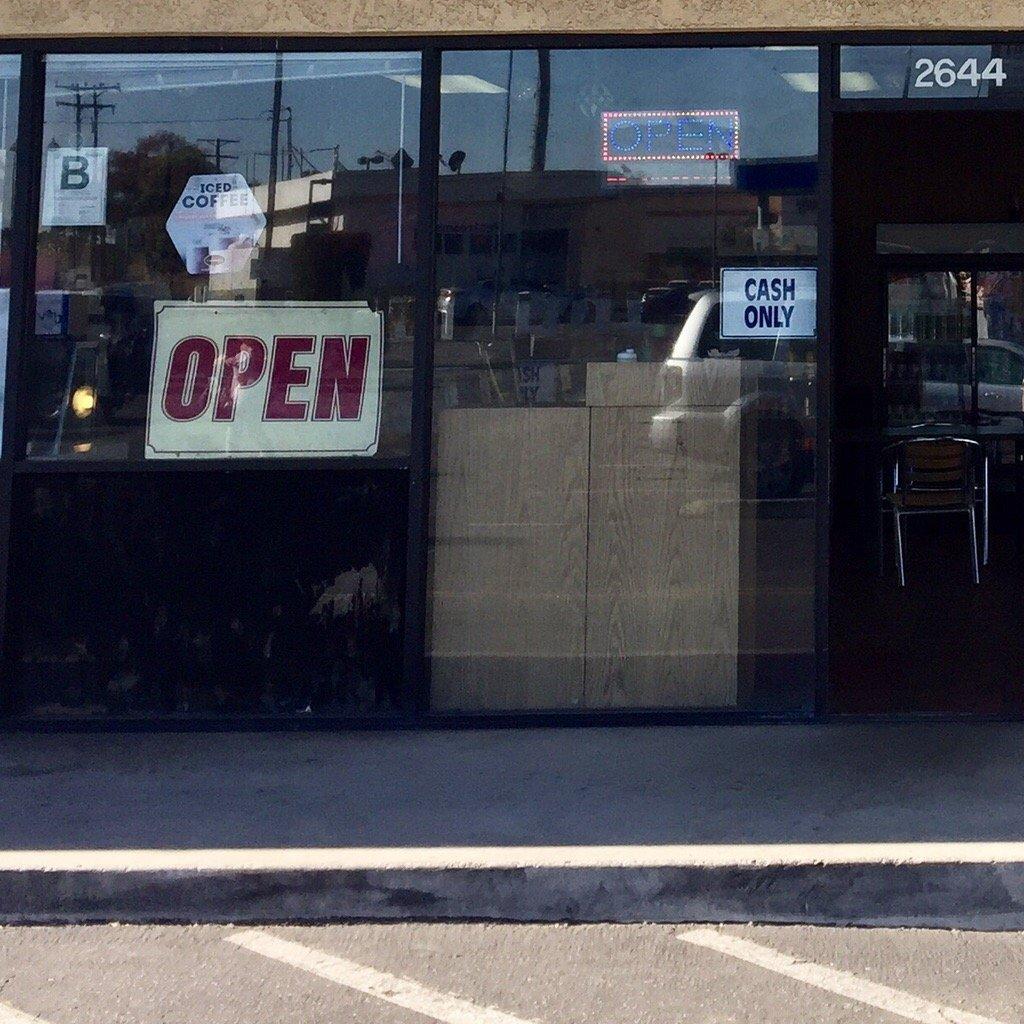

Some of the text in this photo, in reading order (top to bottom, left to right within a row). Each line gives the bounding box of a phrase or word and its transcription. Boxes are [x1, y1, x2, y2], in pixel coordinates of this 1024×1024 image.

[914, 57, 1007, 87] 2644
[609, 118, 733, 152] OPEN
[60, 155, 90, 190] B
[182, 194, 248, 208] COFFEE
[200, 182, 232, 193] ICED
[744, 277, 796, 301] CASH
[744, 305, 795, 328] ONLY
[161, 335, 371, 422] OPEN
